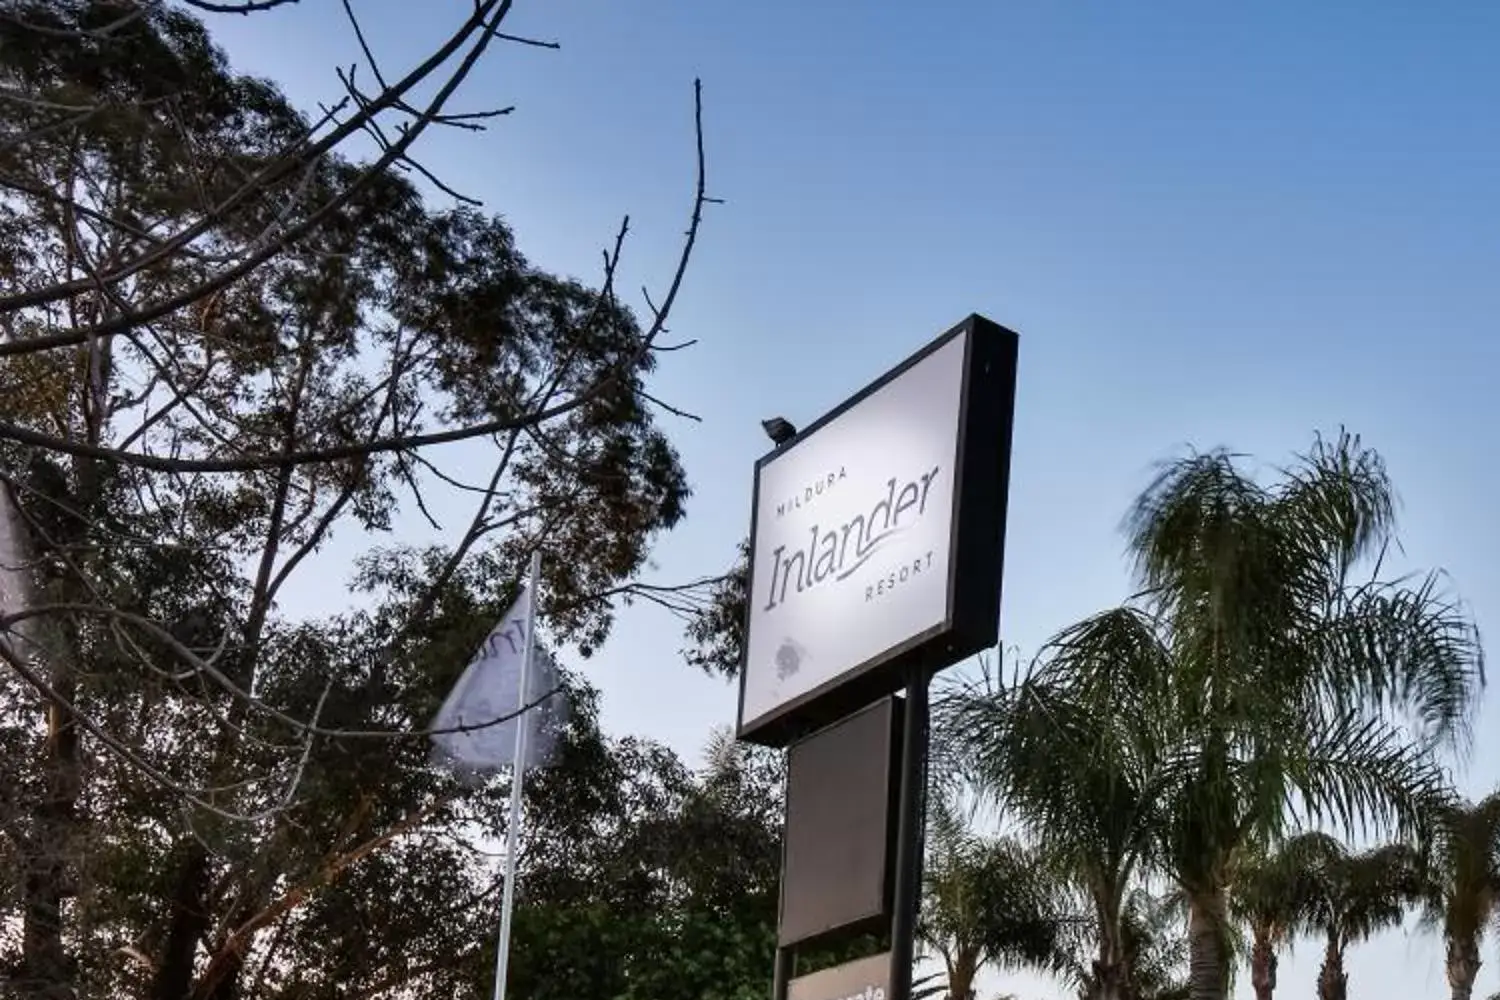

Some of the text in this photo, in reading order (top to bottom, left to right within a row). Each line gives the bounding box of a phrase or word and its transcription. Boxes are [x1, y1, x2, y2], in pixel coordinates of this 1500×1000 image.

[776, 466, 847, 517] MILDURA
[764, 465, 939, 612] Inlander
[865, 551, 933, 602] RESORT
